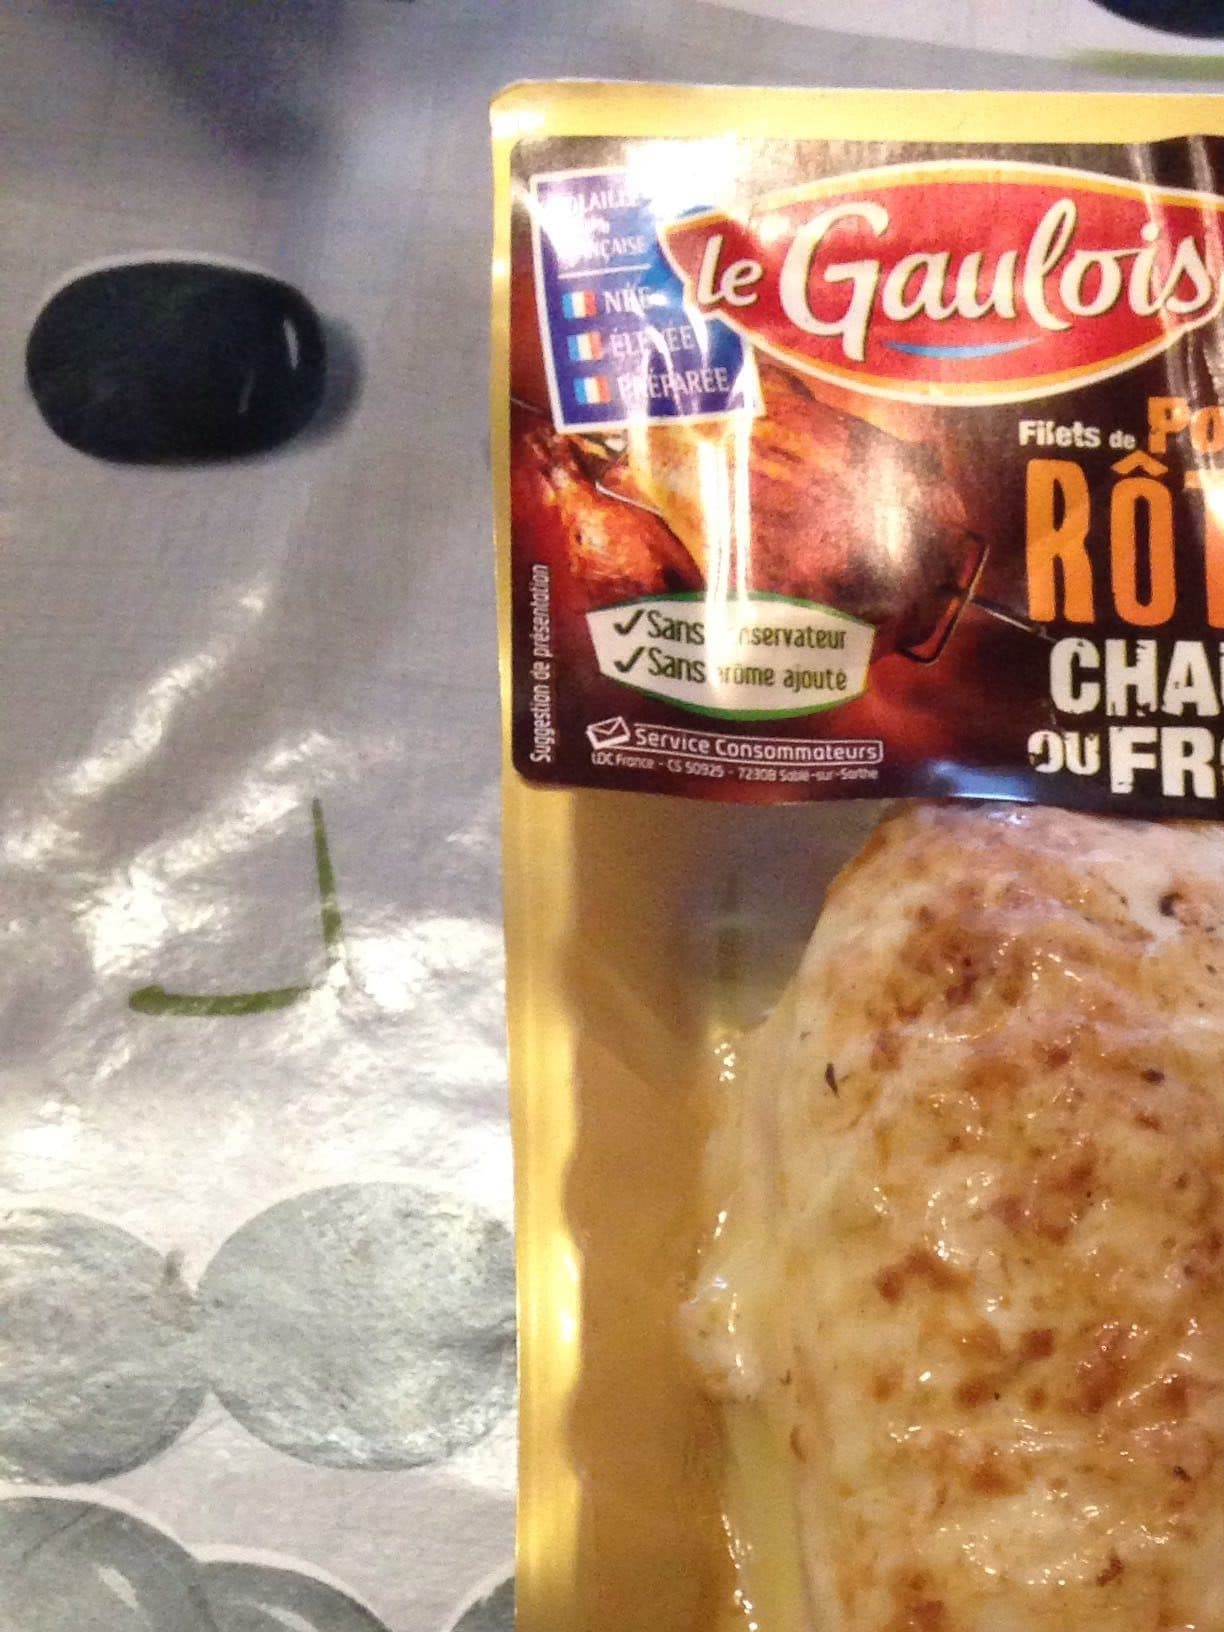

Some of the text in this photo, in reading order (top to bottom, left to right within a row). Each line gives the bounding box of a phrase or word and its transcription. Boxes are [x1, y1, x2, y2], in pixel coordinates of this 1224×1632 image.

[695, 198, 1213, 363] le Gaulois
[1018, 421, 1101, 450] Filets
[1109, 428, 1137, 450] de
[647, 609, 705, 646] Sans
[529, 564, 556, 763] Suggestion de présentation
[647, 646, 706, 684] Sans
[783, 664, 848, 692] ajouté
[616, 754, 655, 770] France
[634, 728, 878, 761] Service Consommateurs
